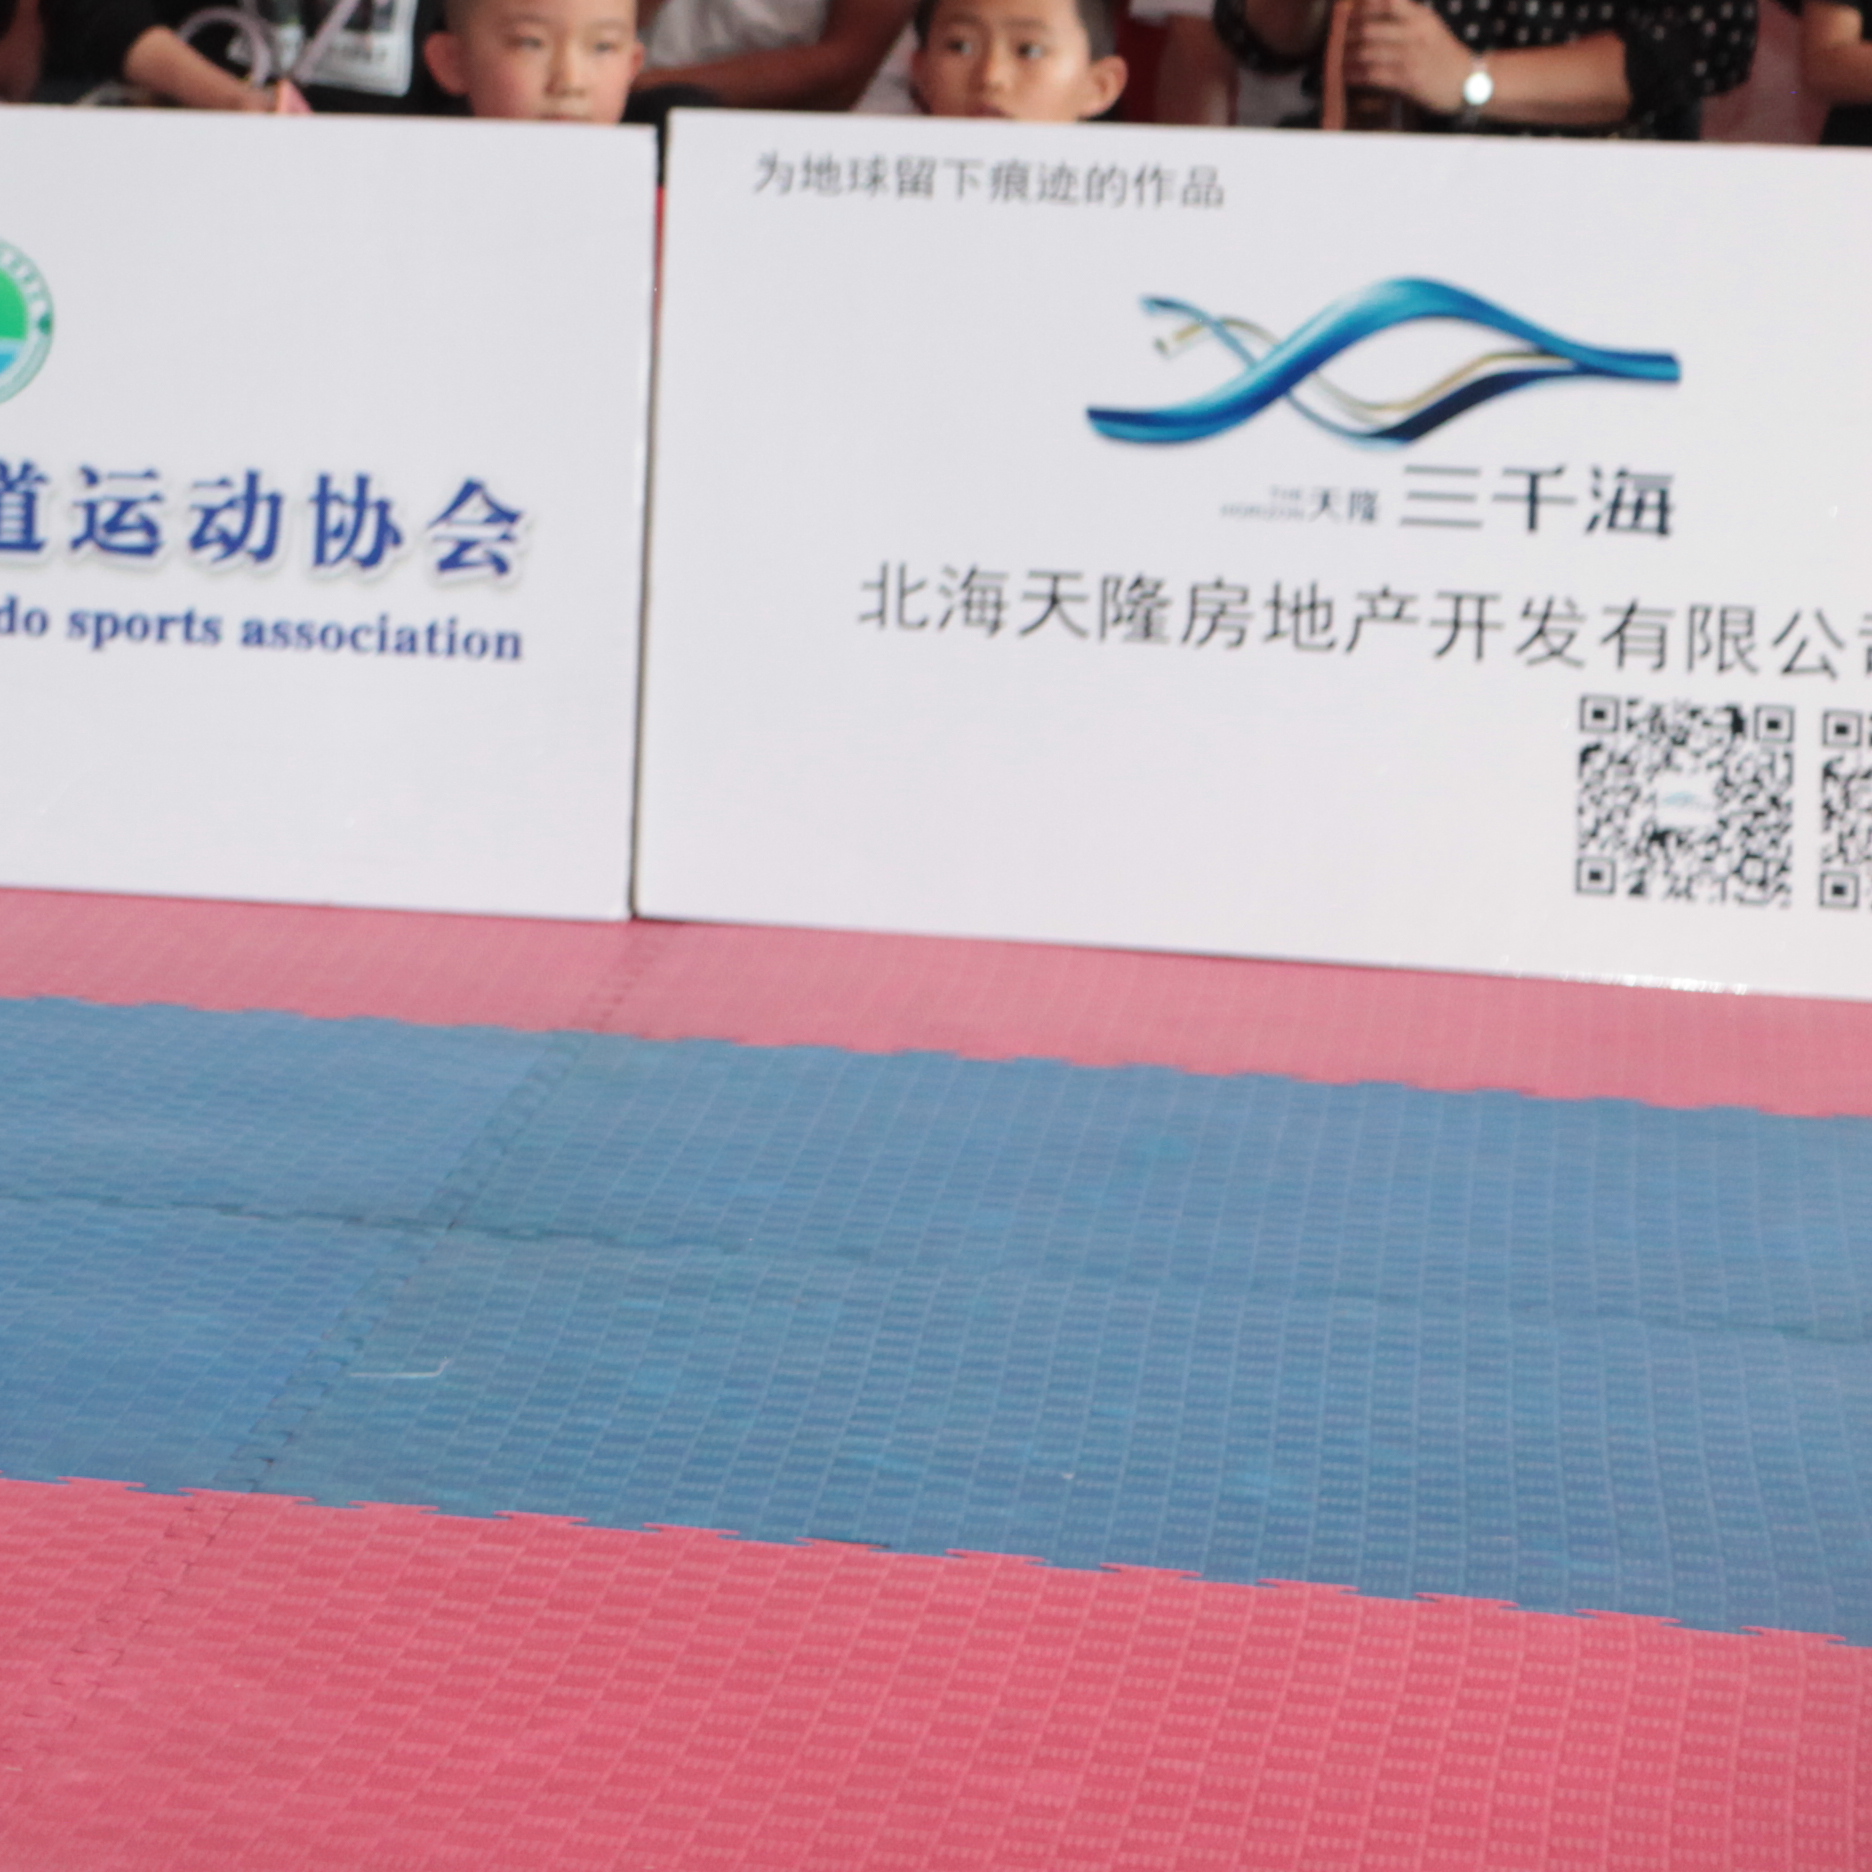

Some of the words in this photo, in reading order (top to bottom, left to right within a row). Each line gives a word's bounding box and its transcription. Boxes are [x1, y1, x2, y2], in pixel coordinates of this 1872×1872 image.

[755, 149, 1225, 209] 为地球留下痕迹的作品
[1400, 463, 1675, 536] 三千海
[66, 605, 223, 652] sports
[239, 612, 524, 661] association
